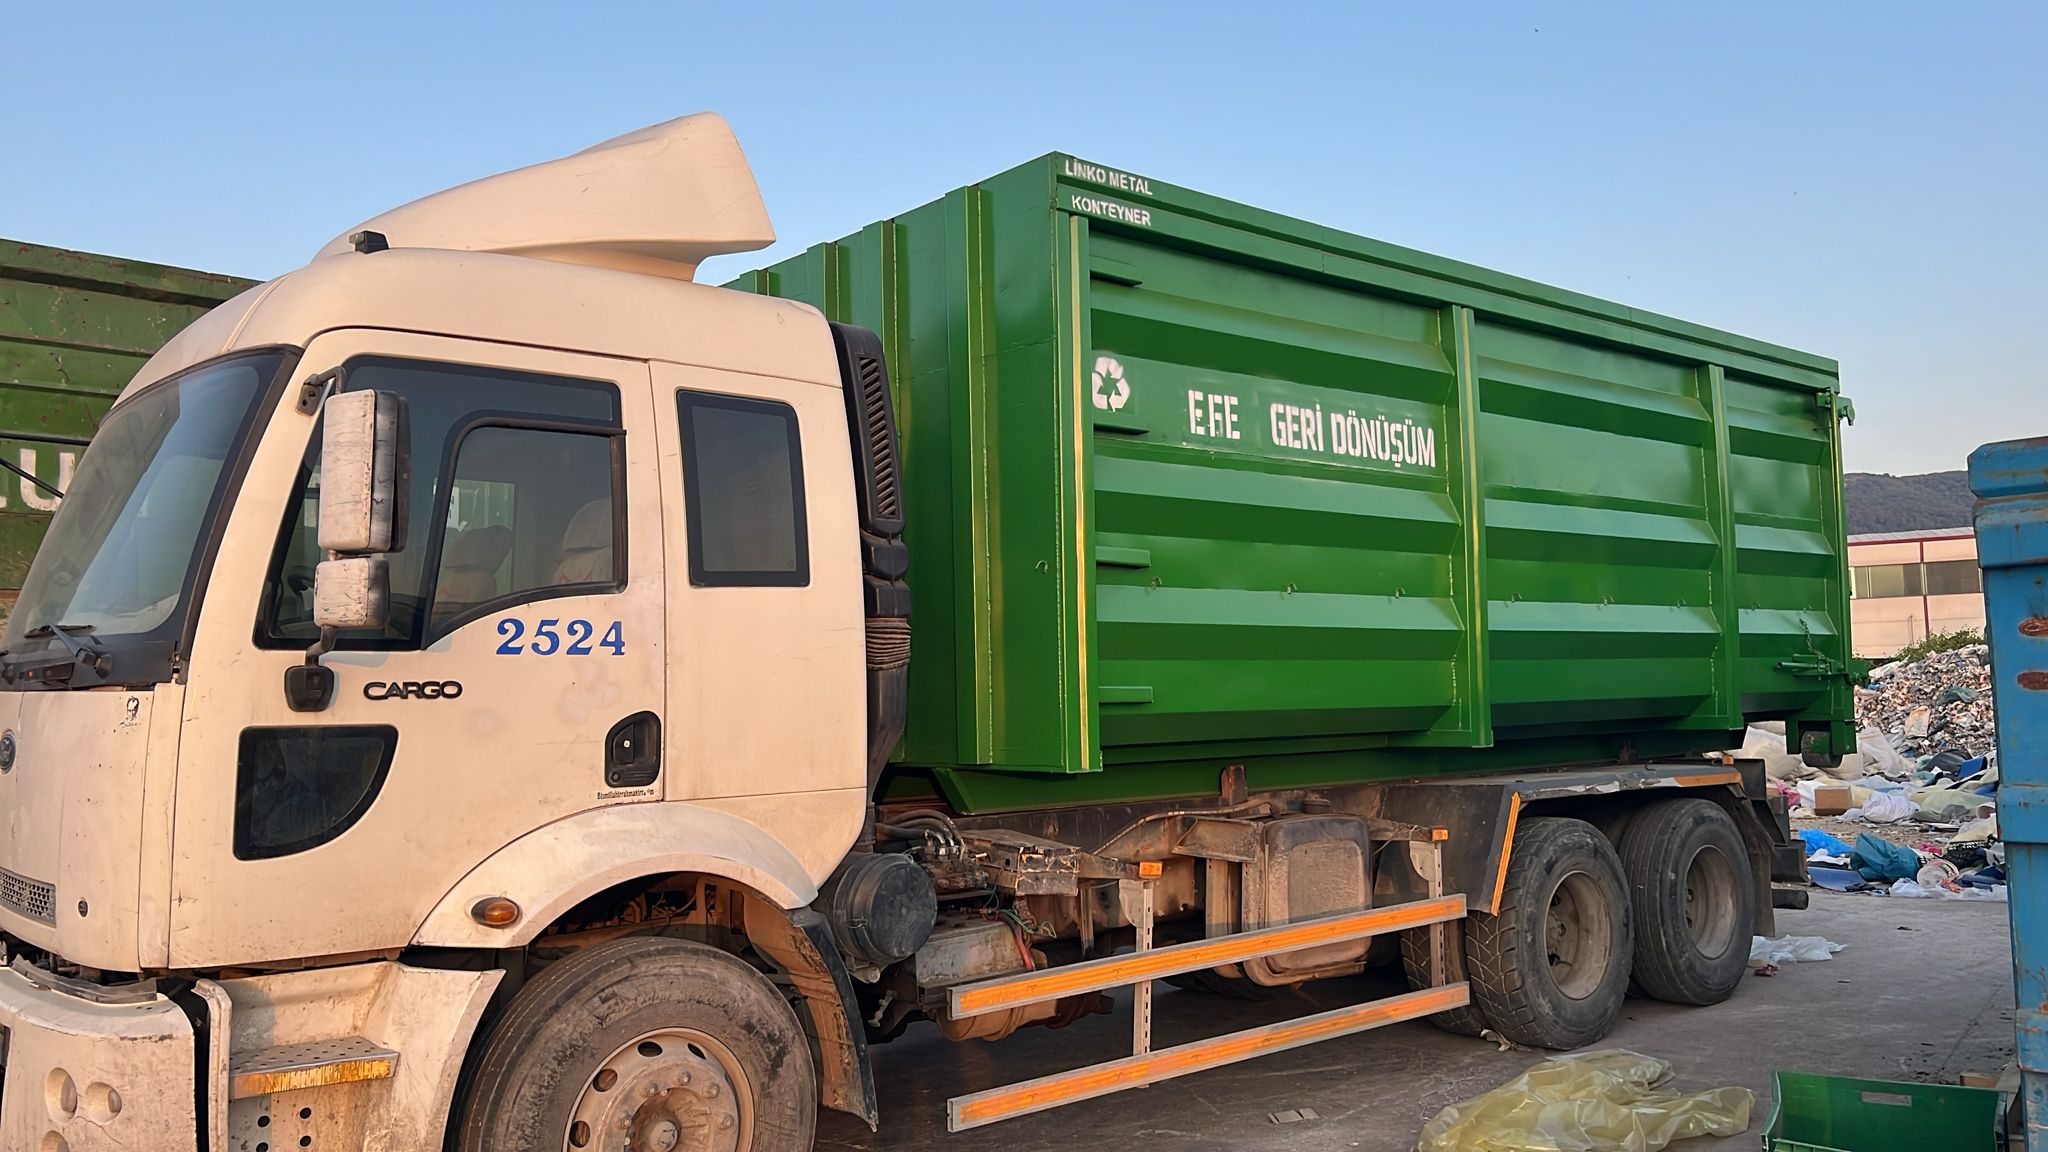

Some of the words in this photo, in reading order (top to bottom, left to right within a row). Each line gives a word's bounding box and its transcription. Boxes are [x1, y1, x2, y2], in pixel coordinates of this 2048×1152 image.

[1065, 159, 1106, 183] LİNKO
[1109, 171, 1153, 195] METAL
[1071, 194, 1152, 226] KONTEYNER
[1188, 389, 1241, 440] EFE
[1270, 402, 1325, 452] GERİ
[1331, 410, 1436, 468] DÖNÜŞÜM
[0, 447, 75, 511] U
[495, 617, 626, 656] 2524
[363, 680, 463, 701] CARGO
